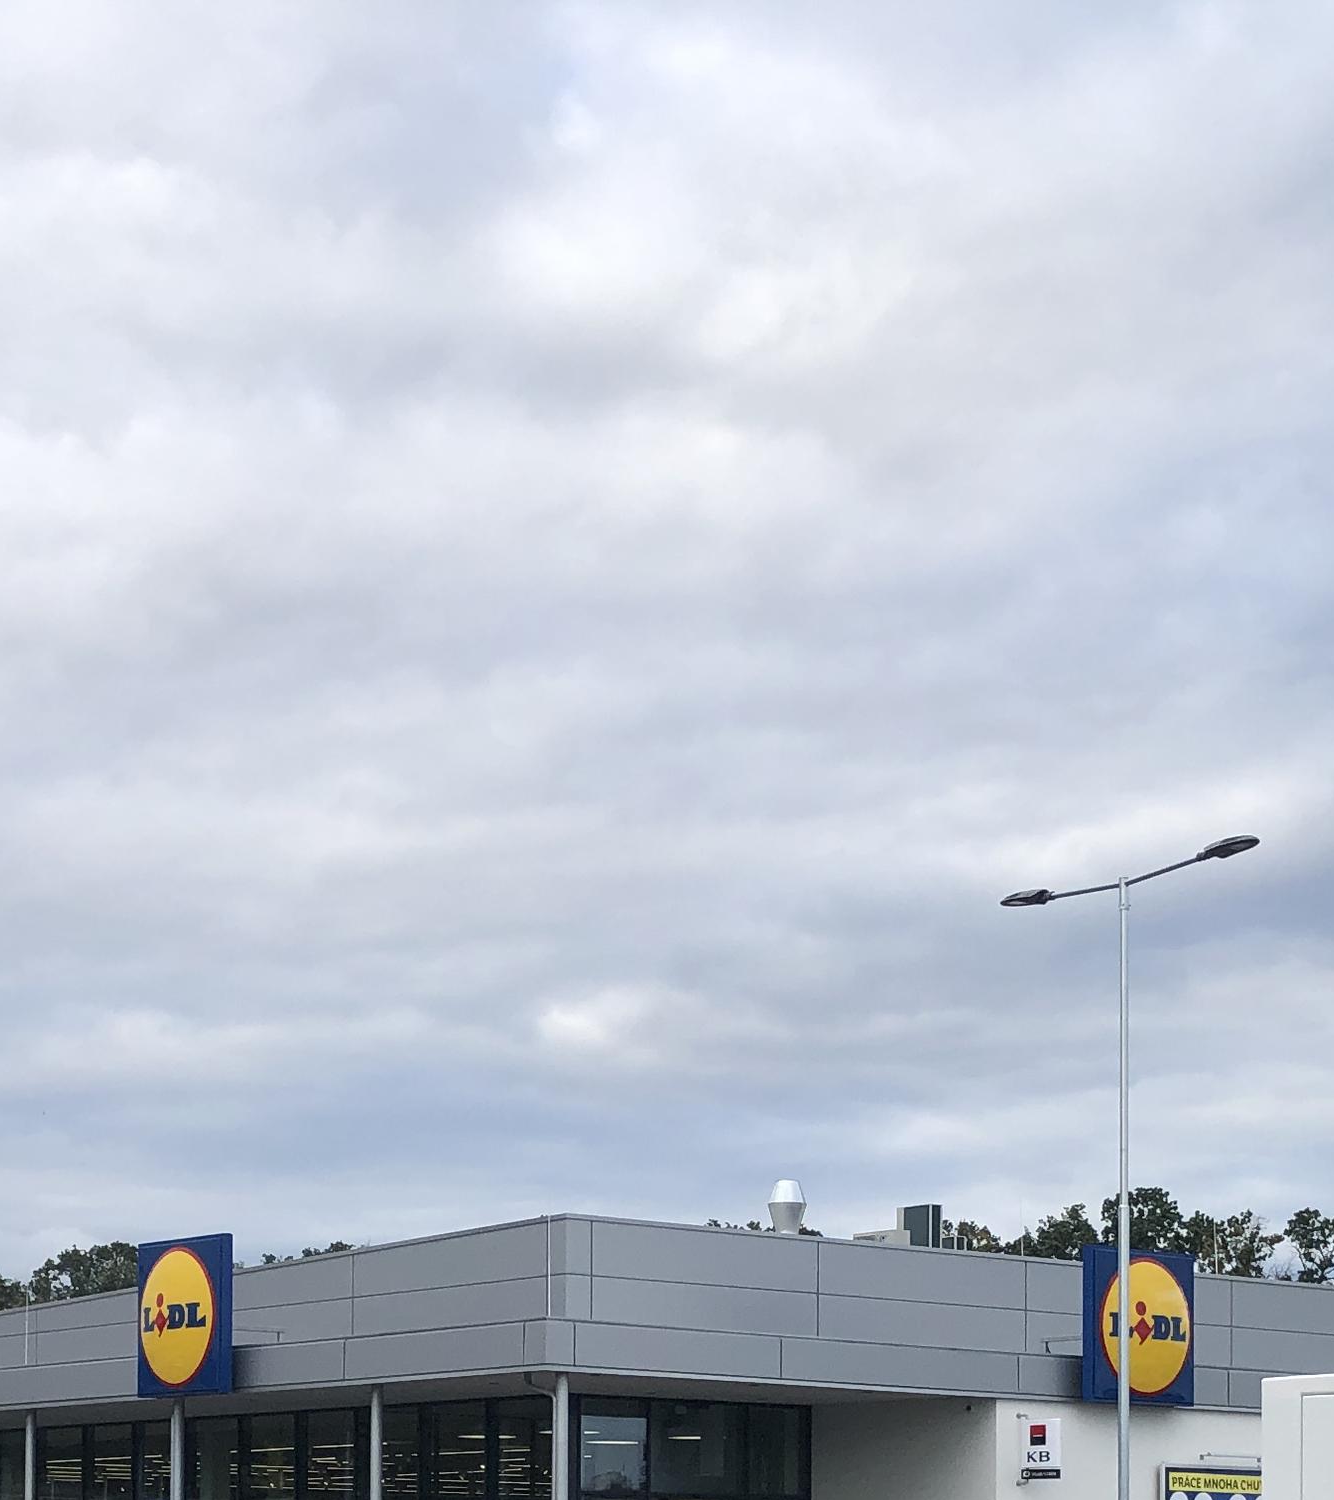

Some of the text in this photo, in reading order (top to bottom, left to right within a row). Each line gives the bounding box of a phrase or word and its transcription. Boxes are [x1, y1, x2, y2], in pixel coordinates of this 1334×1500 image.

[1027, 1450, 1051, 1463] KB
[1172, 1475, 1261, 1491] PRÁCE MNOHA CHU
